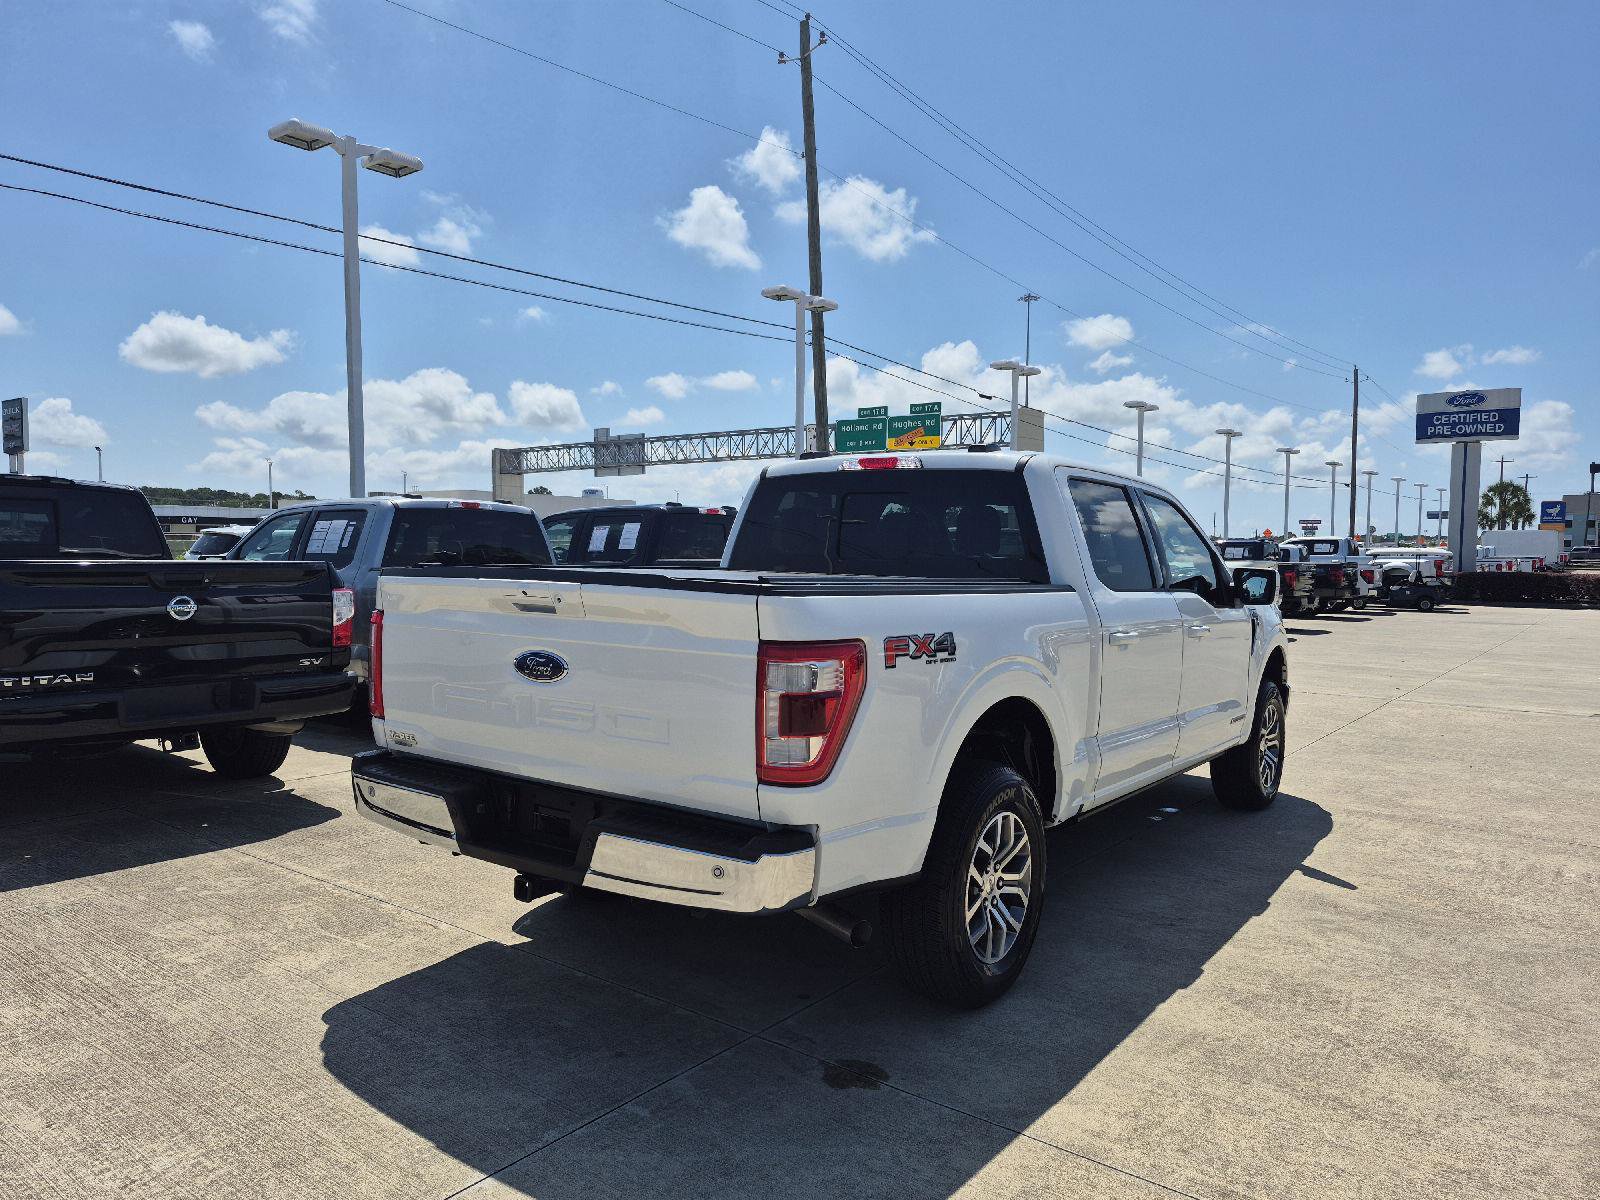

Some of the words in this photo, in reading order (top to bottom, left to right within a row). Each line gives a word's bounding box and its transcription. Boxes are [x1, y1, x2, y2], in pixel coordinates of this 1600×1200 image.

[925, 404, 932, 412] 17
[892, 420, 922, 430] Hughes
[925, 418, 936, 426] Rd
[1433, 411, 1499, 425] CERTIFIED
[841, 424, 869, 432] Holland
[873, 422, 883, 430] Rd
[1427, 423, 1505, 436] PRE-OWNED
[181, 516, 198, 524] GAY
[883, 631, 957, 670] FX4
[299, 657, 323, 666] SV
[0, 672, 94, 687] TITAN
